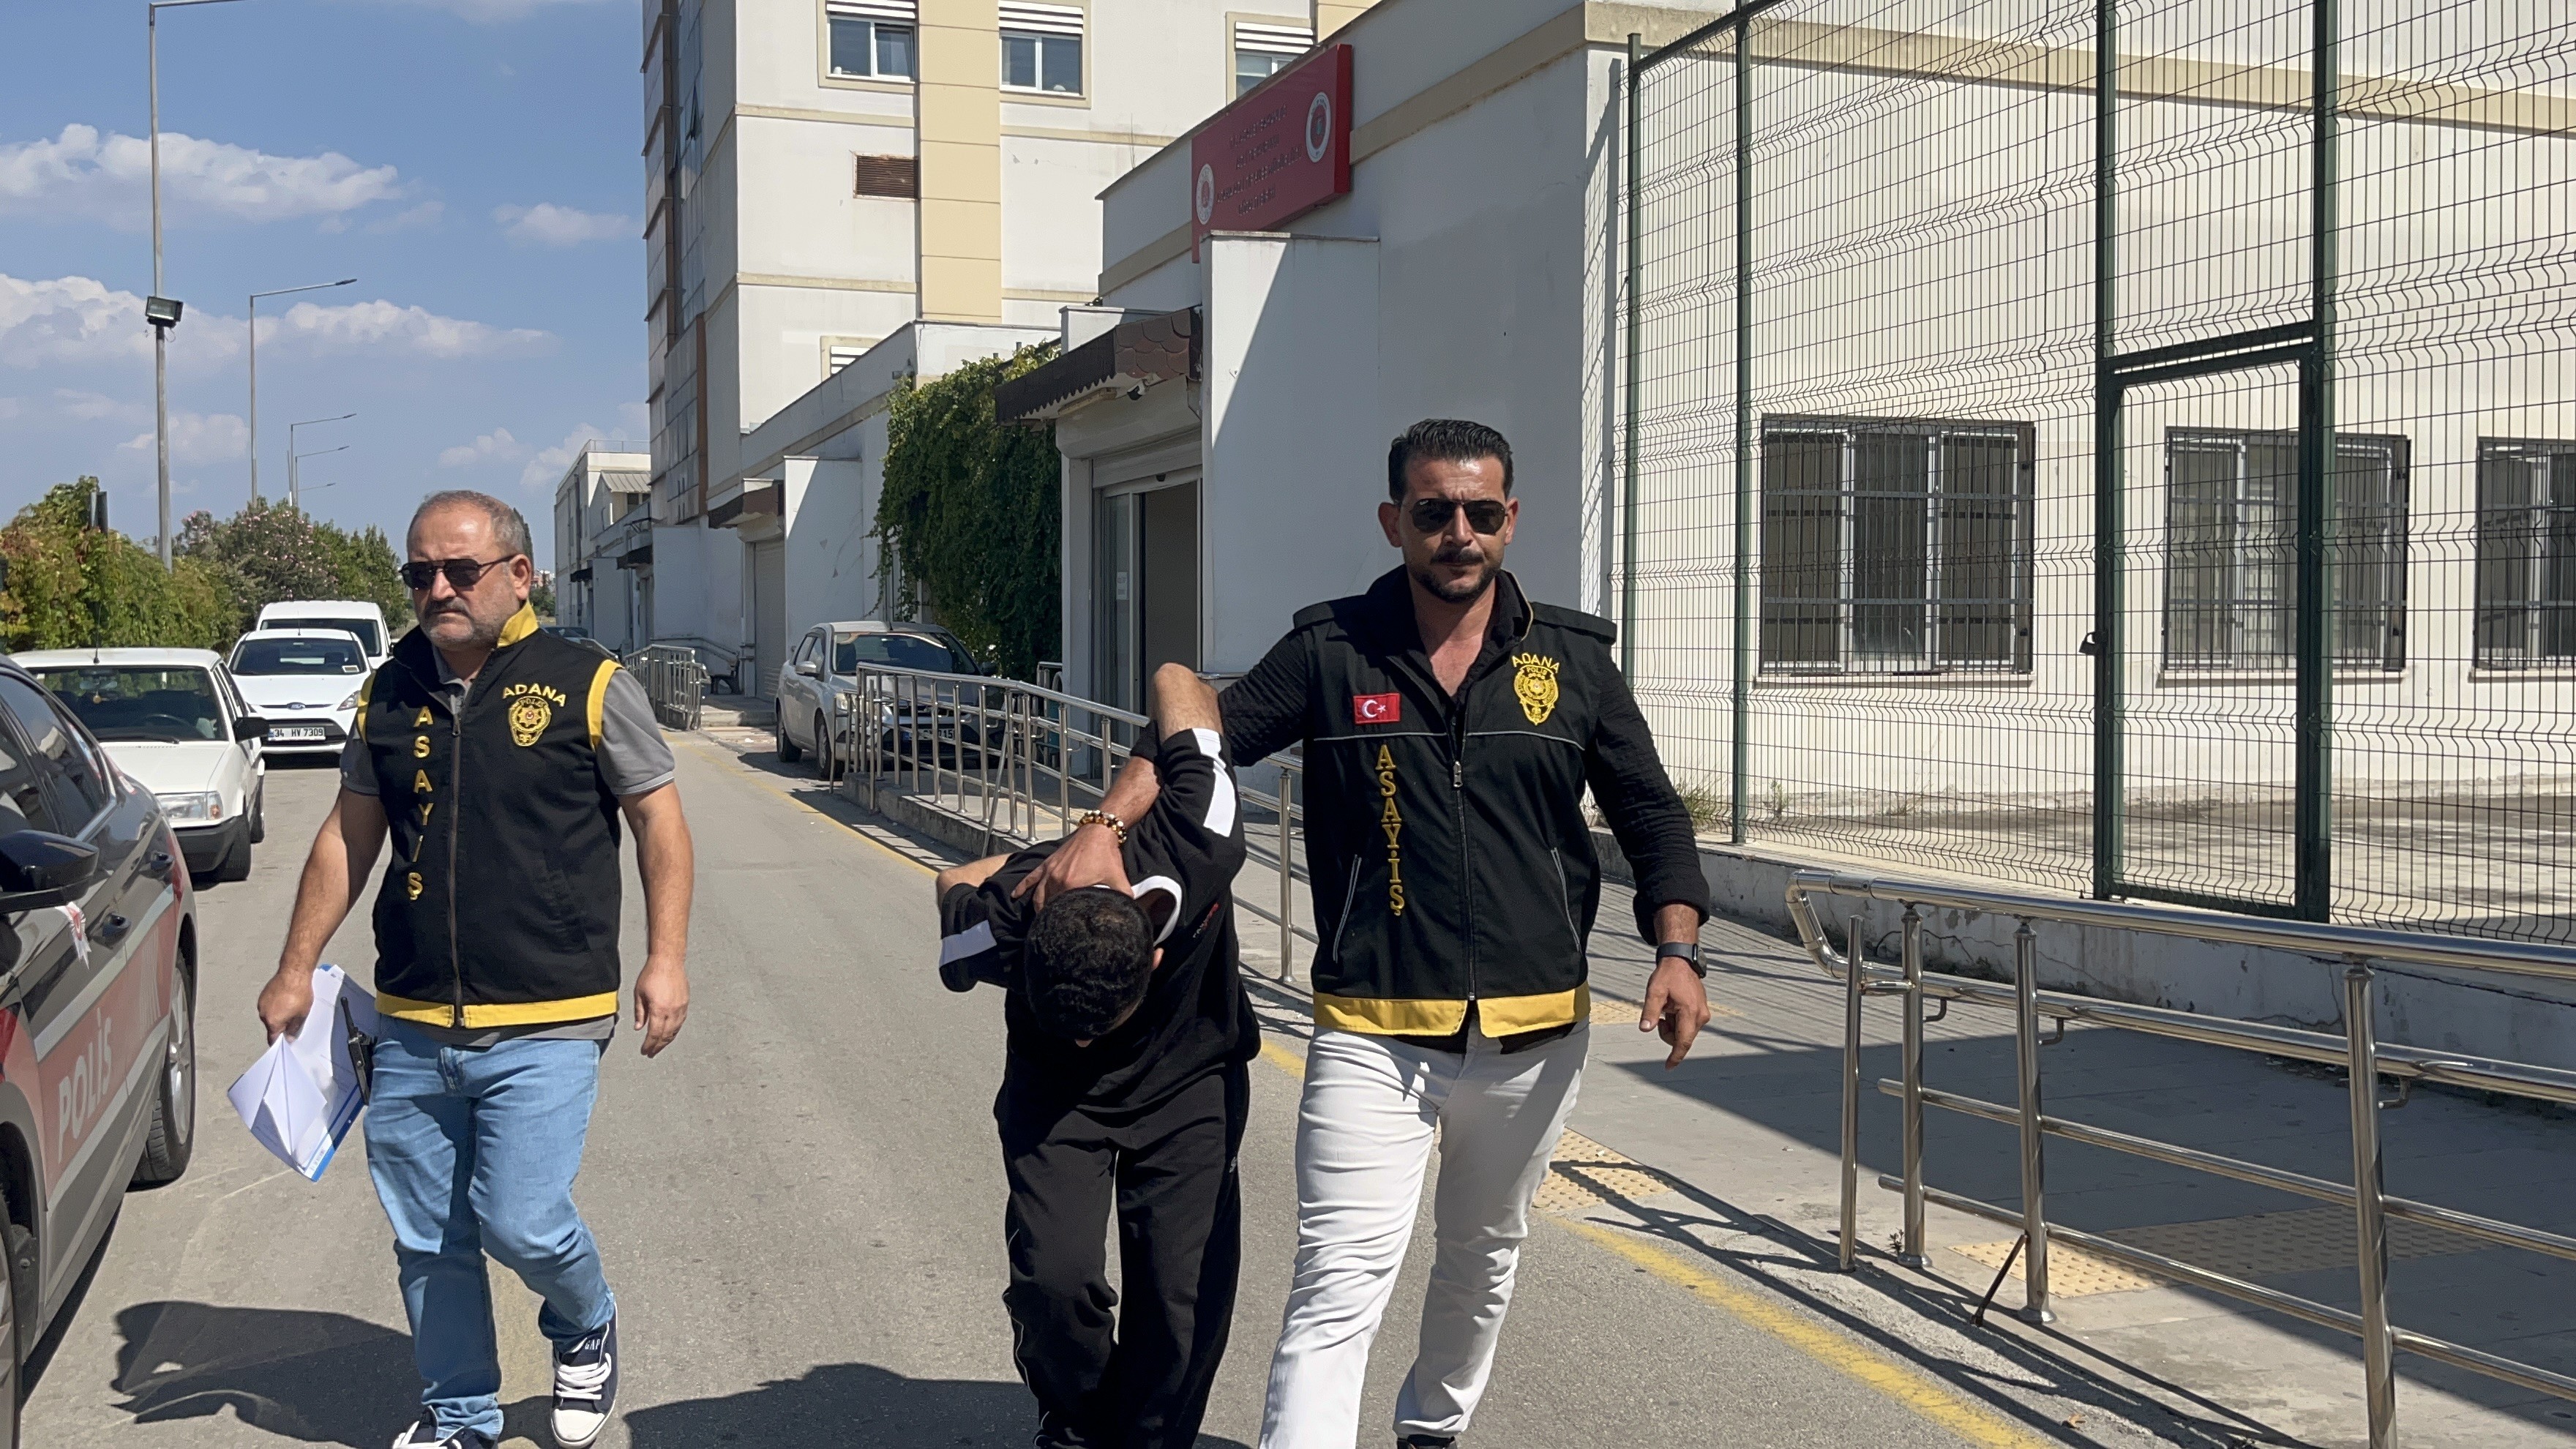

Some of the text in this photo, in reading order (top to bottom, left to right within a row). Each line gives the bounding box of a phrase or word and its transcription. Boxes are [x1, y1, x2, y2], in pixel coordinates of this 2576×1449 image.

[1511, 653, 1560, 673] ADANA
[502, 683, 566, 707] ADANA
[274, 729, 285, 737] 34
[303, 727, 323, 737] 7309
[1375, 744, 1405, 916] ASAYİŞ
[58, 1007, 113, 1164] POLİS
[585, 1338, 600, 1350] GAP
